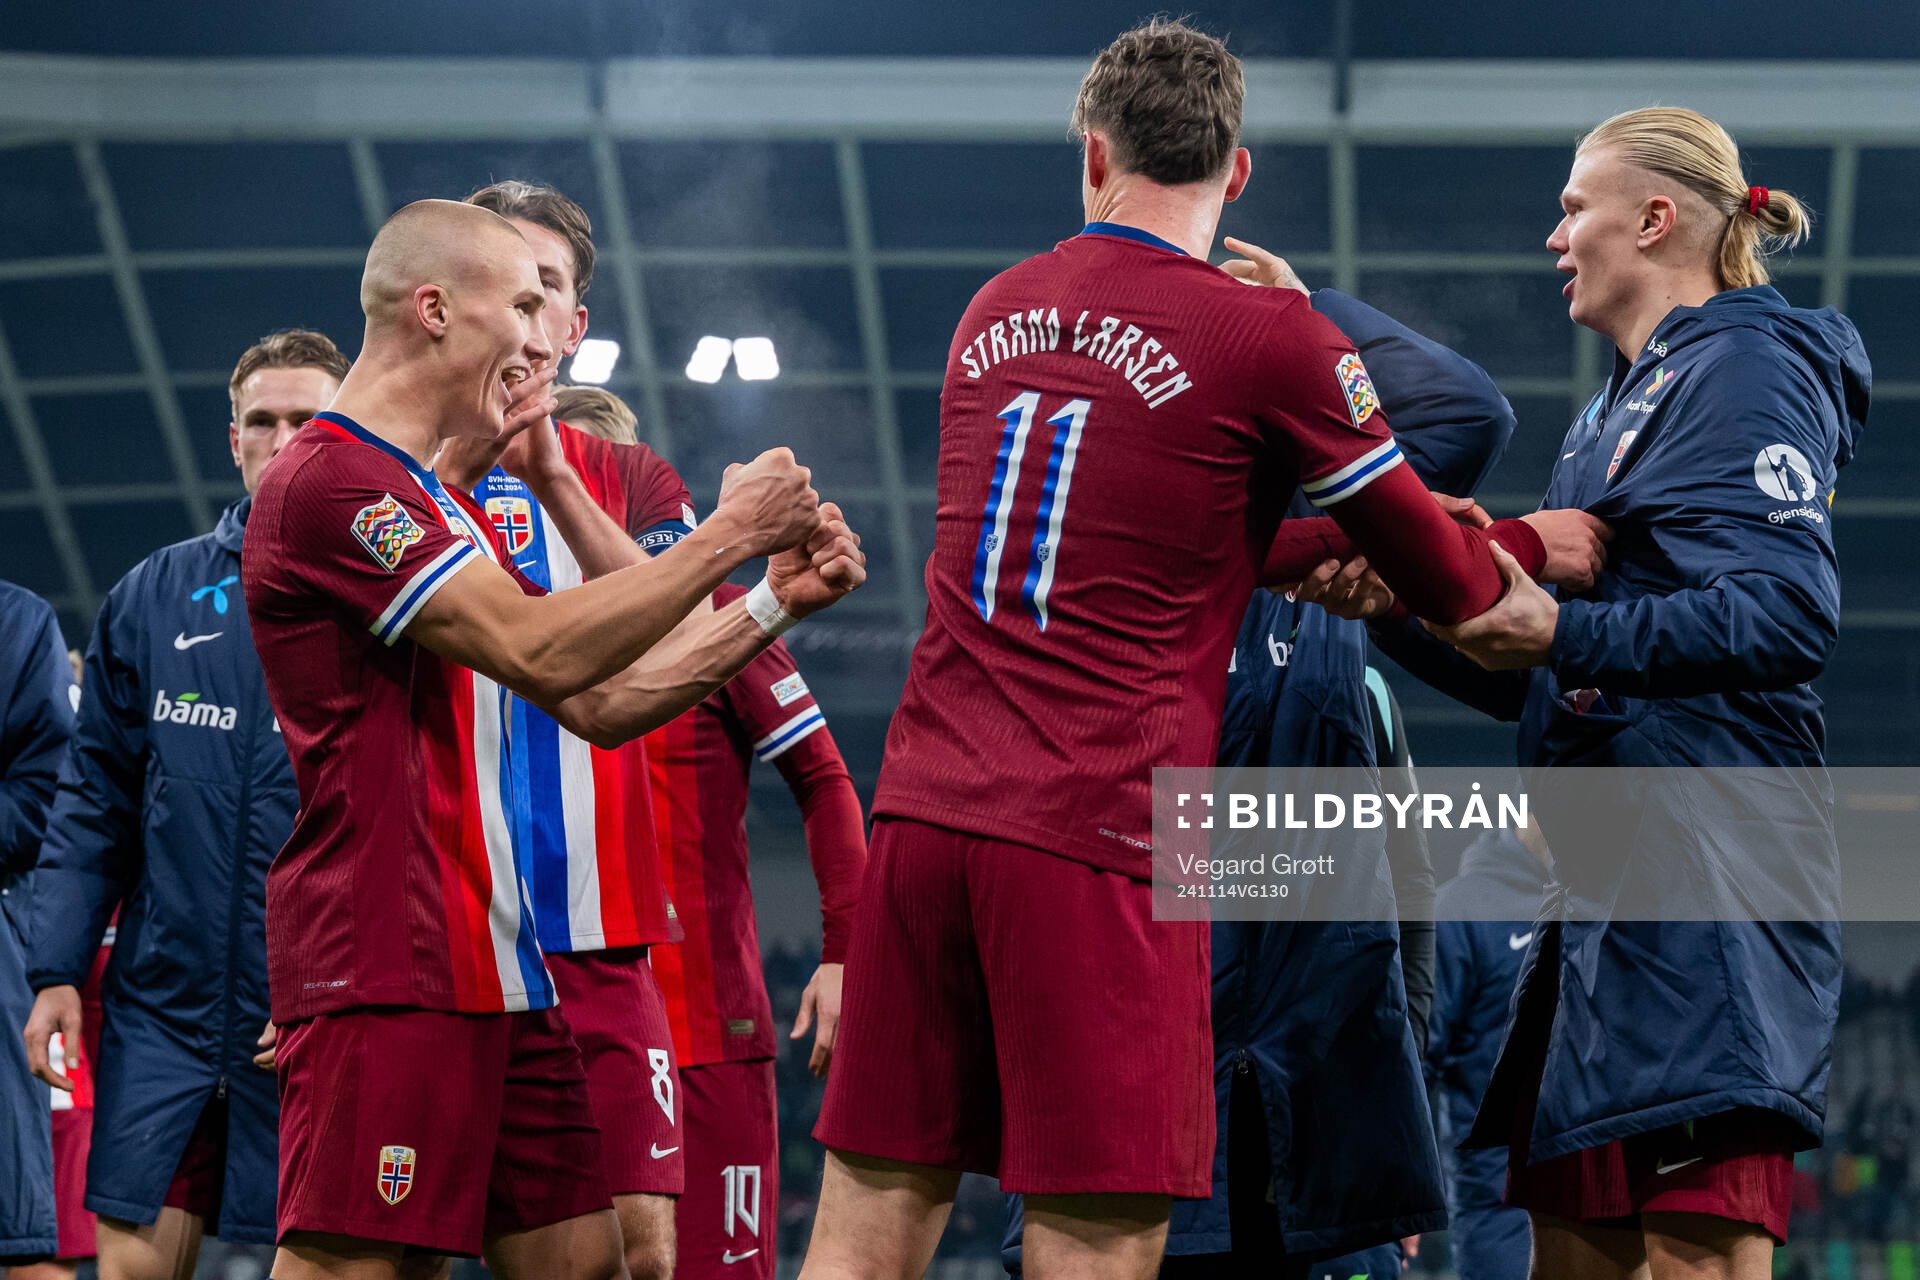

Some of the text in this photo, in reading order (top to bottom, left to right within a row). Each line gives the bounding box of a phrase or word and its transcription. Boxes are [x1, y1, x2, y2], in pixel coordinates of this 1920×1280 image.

[960, 307, 1193, 410] STRAND LARSEN
[970, 390, 1092, 632] 11
[1767, 506, 1824, 525] Gjensidig
[152, 689, 238, 731] bama
[647, 1048, 675, 1127] 8
[720, 1165, 761, 1239] 10
